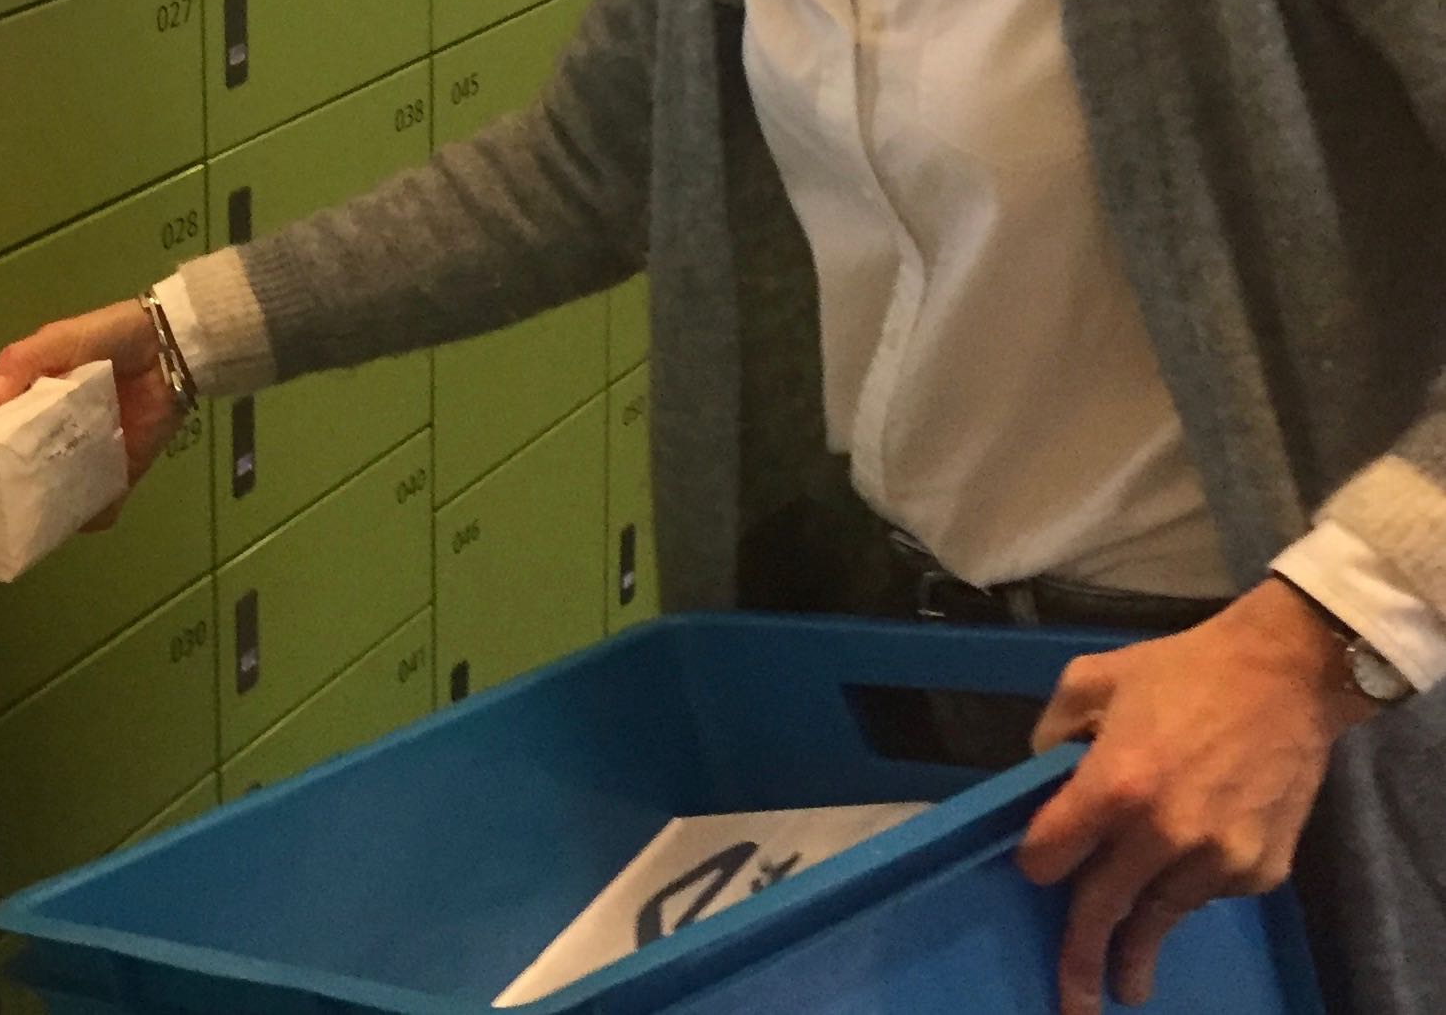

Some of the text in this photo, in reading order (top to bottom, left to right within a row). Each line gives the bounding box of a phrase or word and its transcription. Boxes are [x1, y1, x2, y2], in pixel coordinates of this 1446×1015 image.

[451, 73, 479, 105] 045
[395, 99, 424, 132] 038
[162, 210, 198, 250] 028
